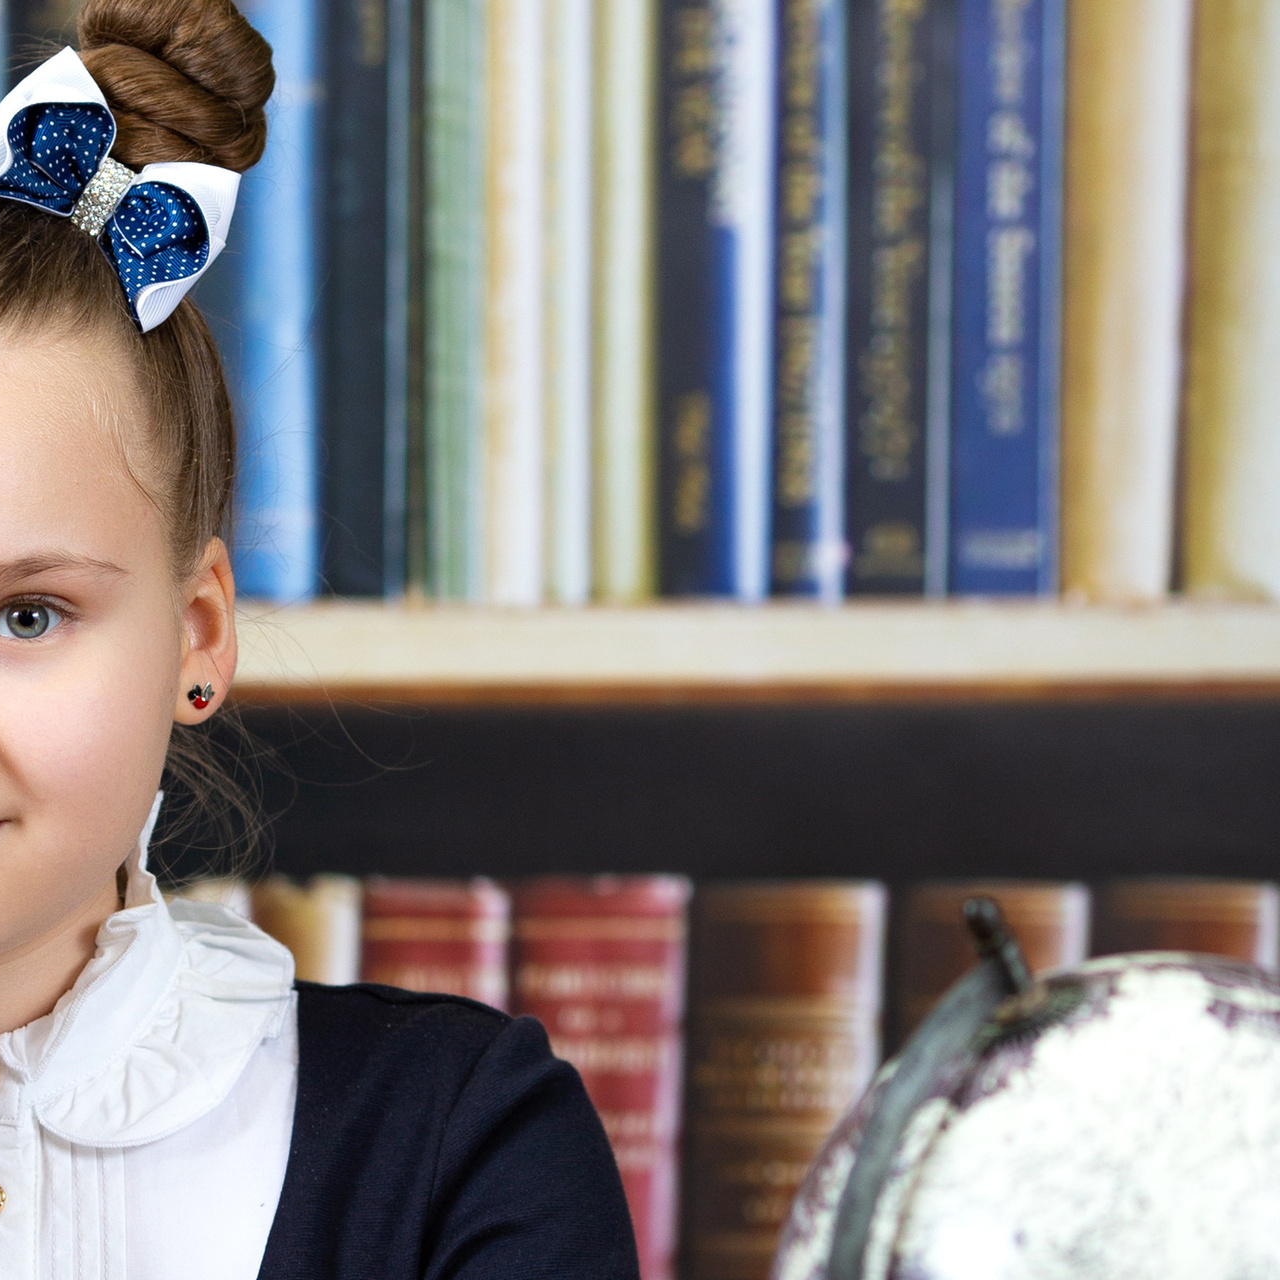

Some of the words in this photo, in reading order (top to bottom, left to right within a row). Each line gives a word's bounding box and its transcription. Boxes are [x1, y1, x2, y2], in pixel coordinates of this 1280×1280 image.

[786, 116, 823, 157] of
[984, 109, 1034, 158] of
[874, 139, 925, 182] of
[783, 163, 820, 218] the
[872, 185, 926, 235] the
[985, 160, 1034, 218] the
